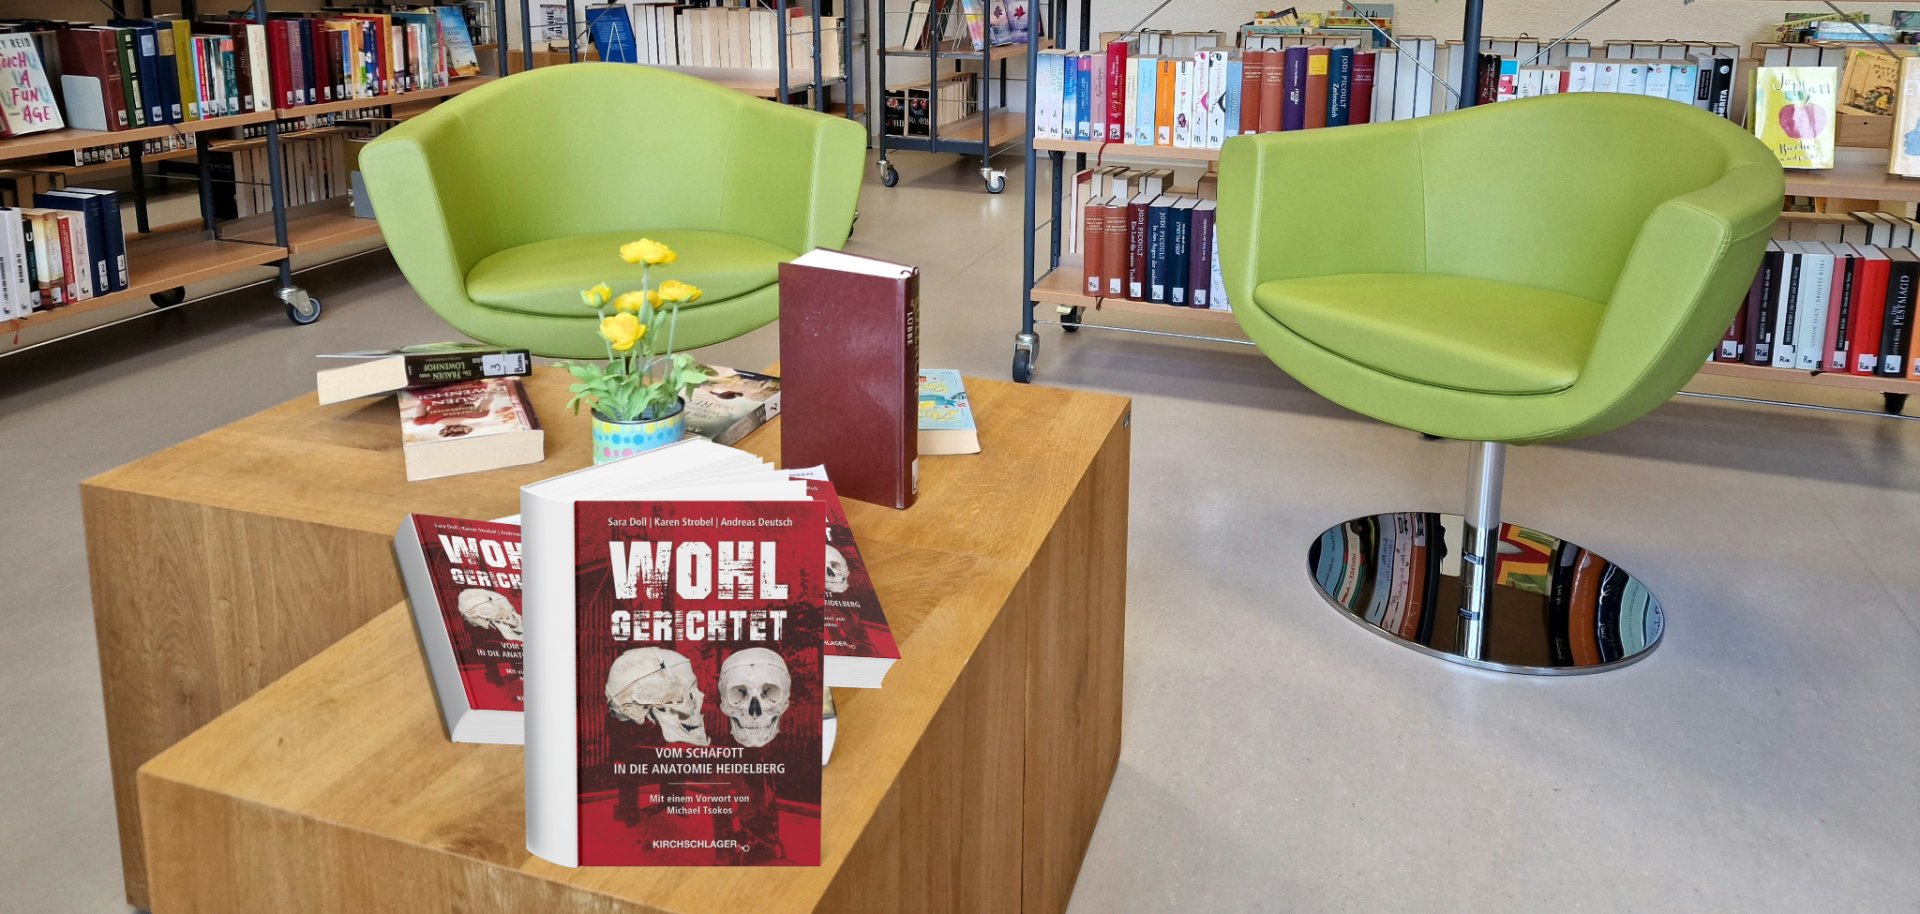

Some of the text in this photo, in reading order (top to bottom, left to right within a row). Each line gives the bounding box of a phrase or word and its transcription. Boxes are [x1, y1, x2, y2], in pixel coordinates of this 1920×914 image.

[11, 38, 31, 48] REID
[21, 69, 31, 88] A
[1339, 55, 1349, 109] JODI PICOULT
[10, 87, 39, 106] FUN
[23, 104, 51, 124] AGE
[101, 263, 106, 273] 2
[1892, 275, 1910, 326] PESTMAGD
[1779, 355, 1790, 363] Rie
[490, 362, 501, 372] 3
[432, 371, 461, 381] FRAUEN
[607, 516, 793, 527] Sara Doll Karen Strobel Andreas Deutsch
[438, 533, 523, 571] WOH
[609, 540, 789, 600] WOHL
[450, 567, 523, 590] GERICH
[824, 599, 861, 608] EIDELBERG
[610, 609, 788, 641] GERICHTET
[500, 641, 520, 650] VOM
[476, 649, 486, 657] IN
[502, 651, 524, 659] ANAT
[655, 747, 745, 759] VOM SCHAFOTT
[613, 763, 786, 774] IN DIE ANATOMIE HEIDELBERG
[649, 794, 665, 803] Mit
[666, 794, 694, 803] einem
[695, 794, 732, 803] Vorwort
[666, 805, 733, 815] Michael Tsokos
[652, 839, 738, 849] KIRCHSCHLAGER
